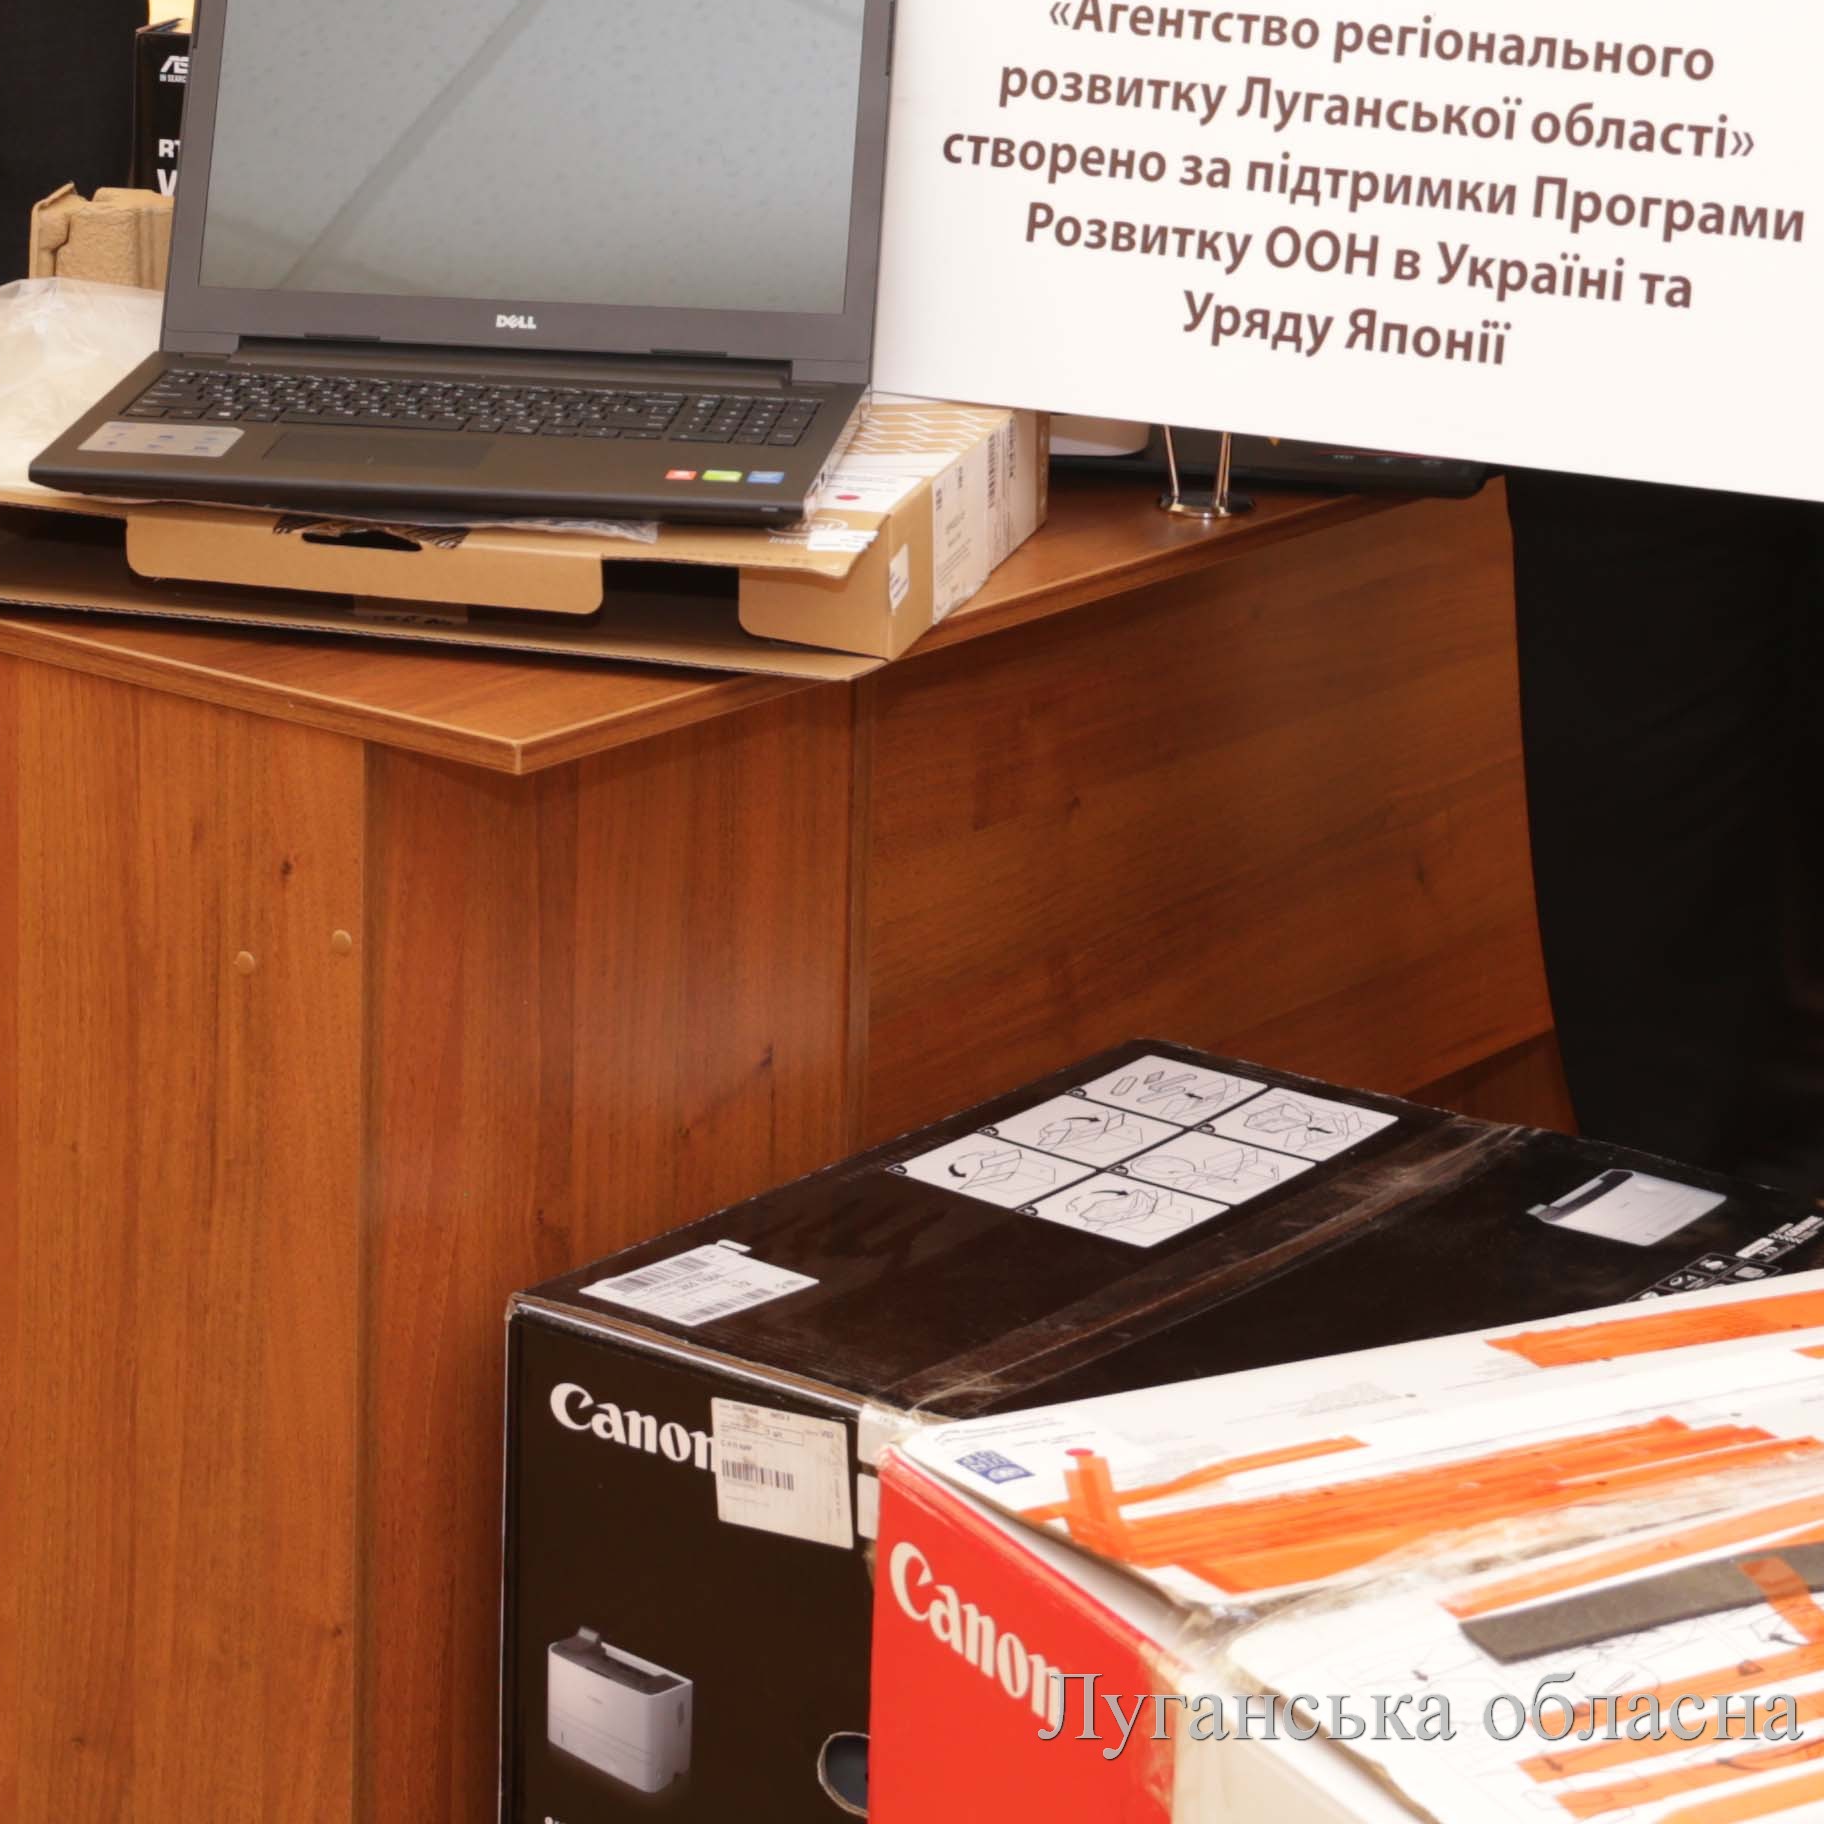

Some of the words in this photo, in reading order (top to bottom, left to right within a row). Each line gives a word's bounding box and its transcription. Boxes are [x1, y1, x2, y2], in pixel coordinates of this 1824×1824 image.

[1333, 13, 1715, 82] регіонального
[997, 65, 1229, 128] розвитку
[1235, 75, 1524, 142] Луганської
[1530, 101, 1756, 160] області»
[941, 132, 1168, 186] створено
[1178, 153, 1232, 190] за
[1245, 150, 1518, 217] підтримки
[1531, 174, 1806, 244] Програми
[1024, 200, 1254, 277] Розвитку
[1264, 224, 1381, 278] ООН
[1392, 247, 1422, 282] в
[1436, 240, 1626, 308] Україні
[1638, 271, 1693, 310] та
[495, 314, 537, 329] DELL
[1182, 288, 1335, 359] Уряду
[1343, 306, 1513, 366] Японії
[889, 1541, 1064, 1729] Canon
